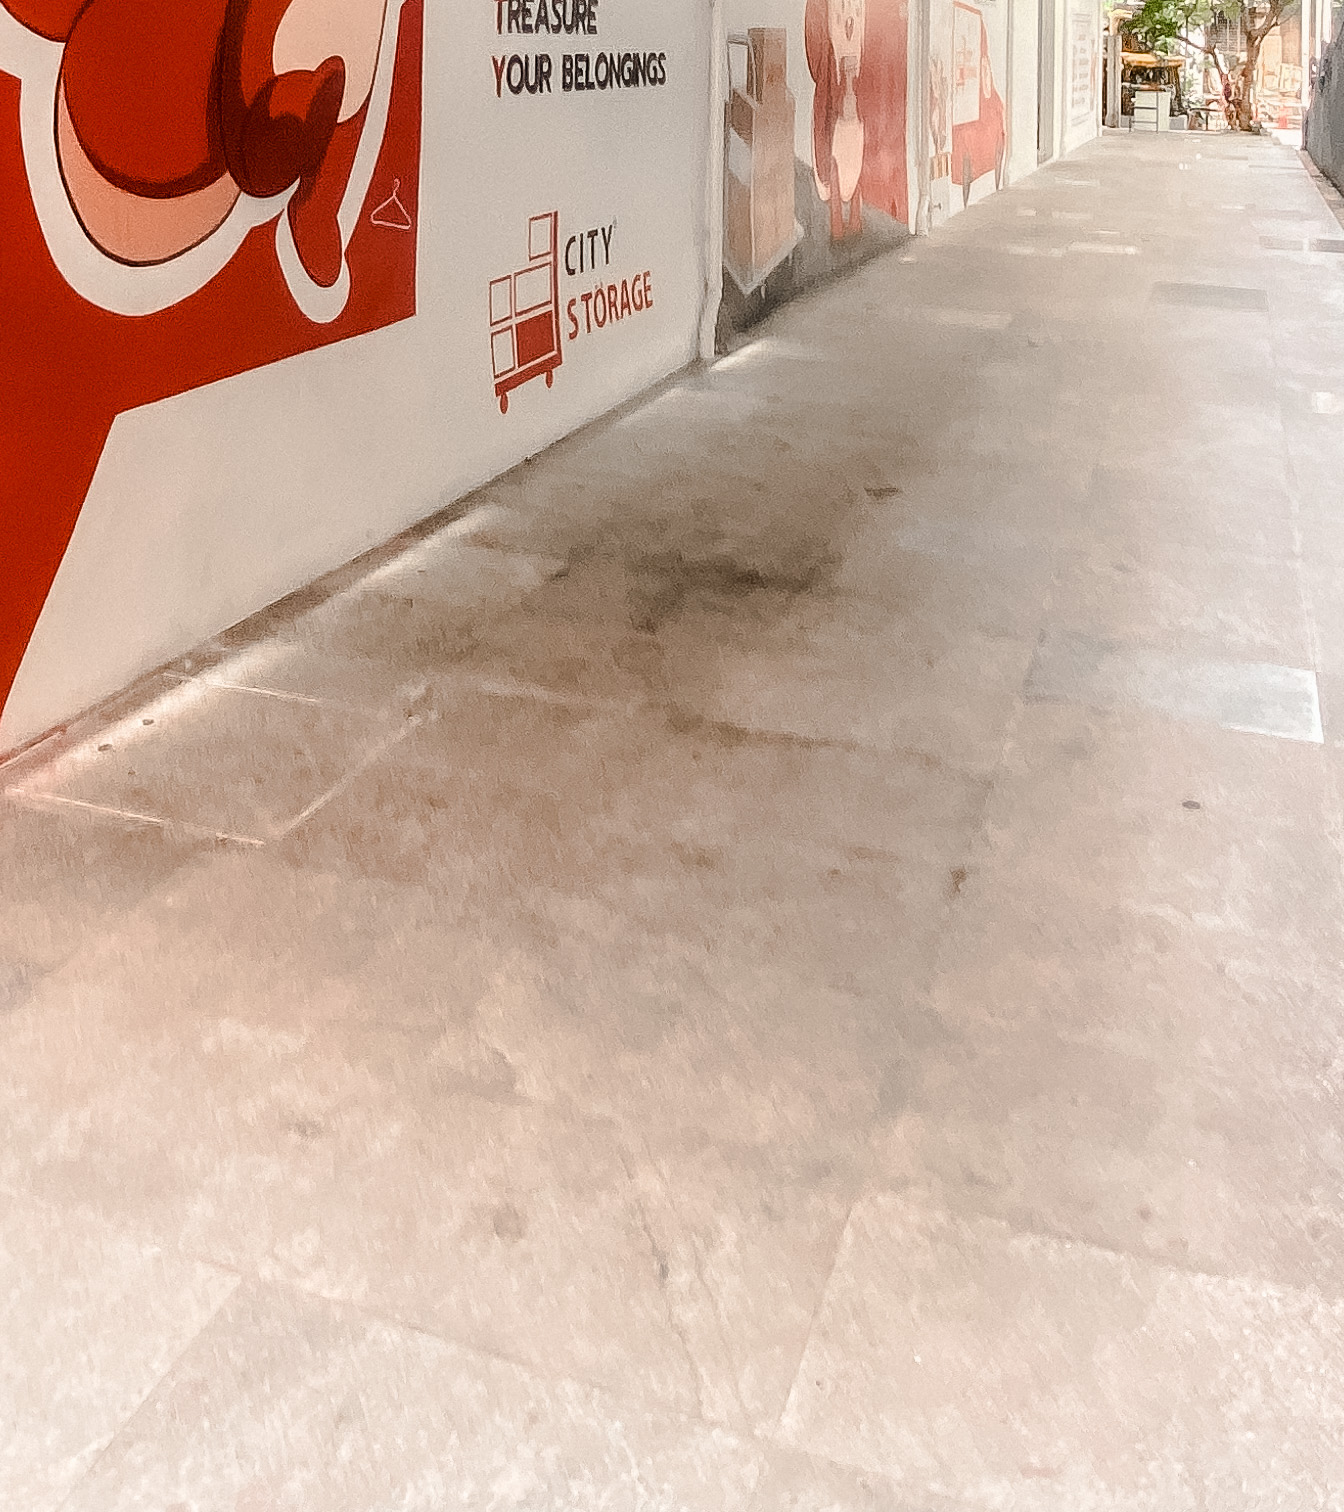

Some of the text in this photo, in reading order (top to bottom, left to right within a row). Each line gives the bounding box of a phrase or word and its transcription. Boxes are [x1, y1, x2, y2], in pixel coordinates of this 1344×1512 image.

[491, 51, 667, 98] YOUR BELONGINGS
[565, 224, 613, 276] CITY
[567, 271, 653, 340] STORAGE
